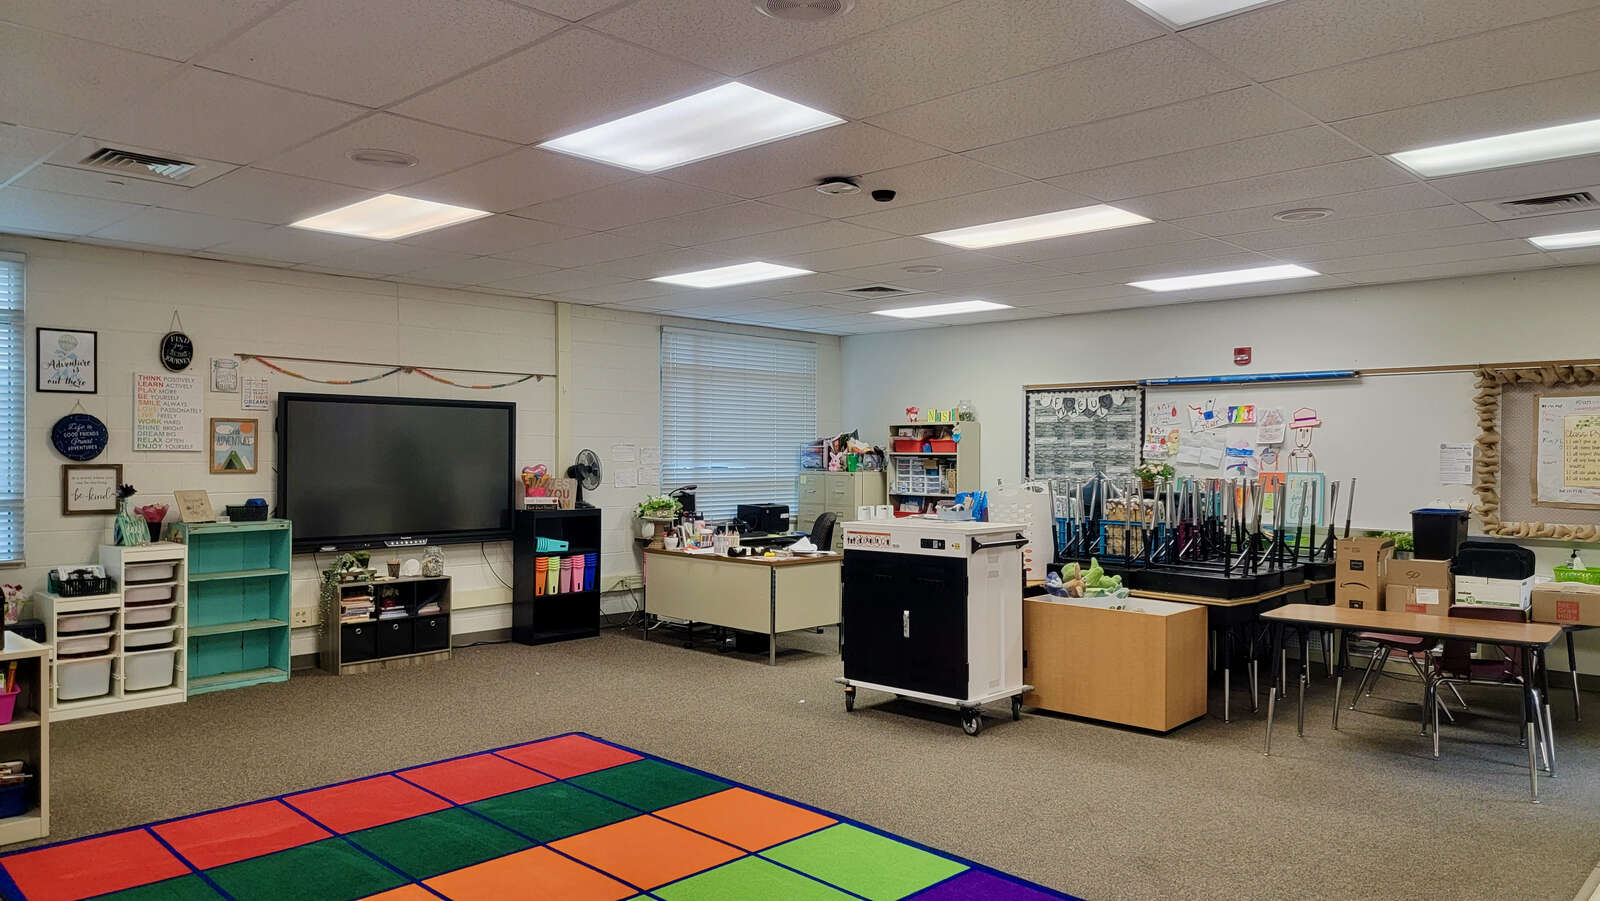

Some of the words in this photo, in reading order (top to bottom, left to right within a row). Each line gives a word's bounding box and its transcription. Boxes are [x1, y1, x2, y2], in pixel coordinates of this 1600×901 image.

[170, 335, 190, 343] FIND
[48, 359, 91, 369] Adventure
[166, 355, 191, 364] JOURNEY
[47, 376, 61, 385] out
[65, 376, 87, 388] there
[1054, 394, 1110, 410] FOCUS
[86, 487, 112, 501] kind
[548, 489, 570, 499] YOU
